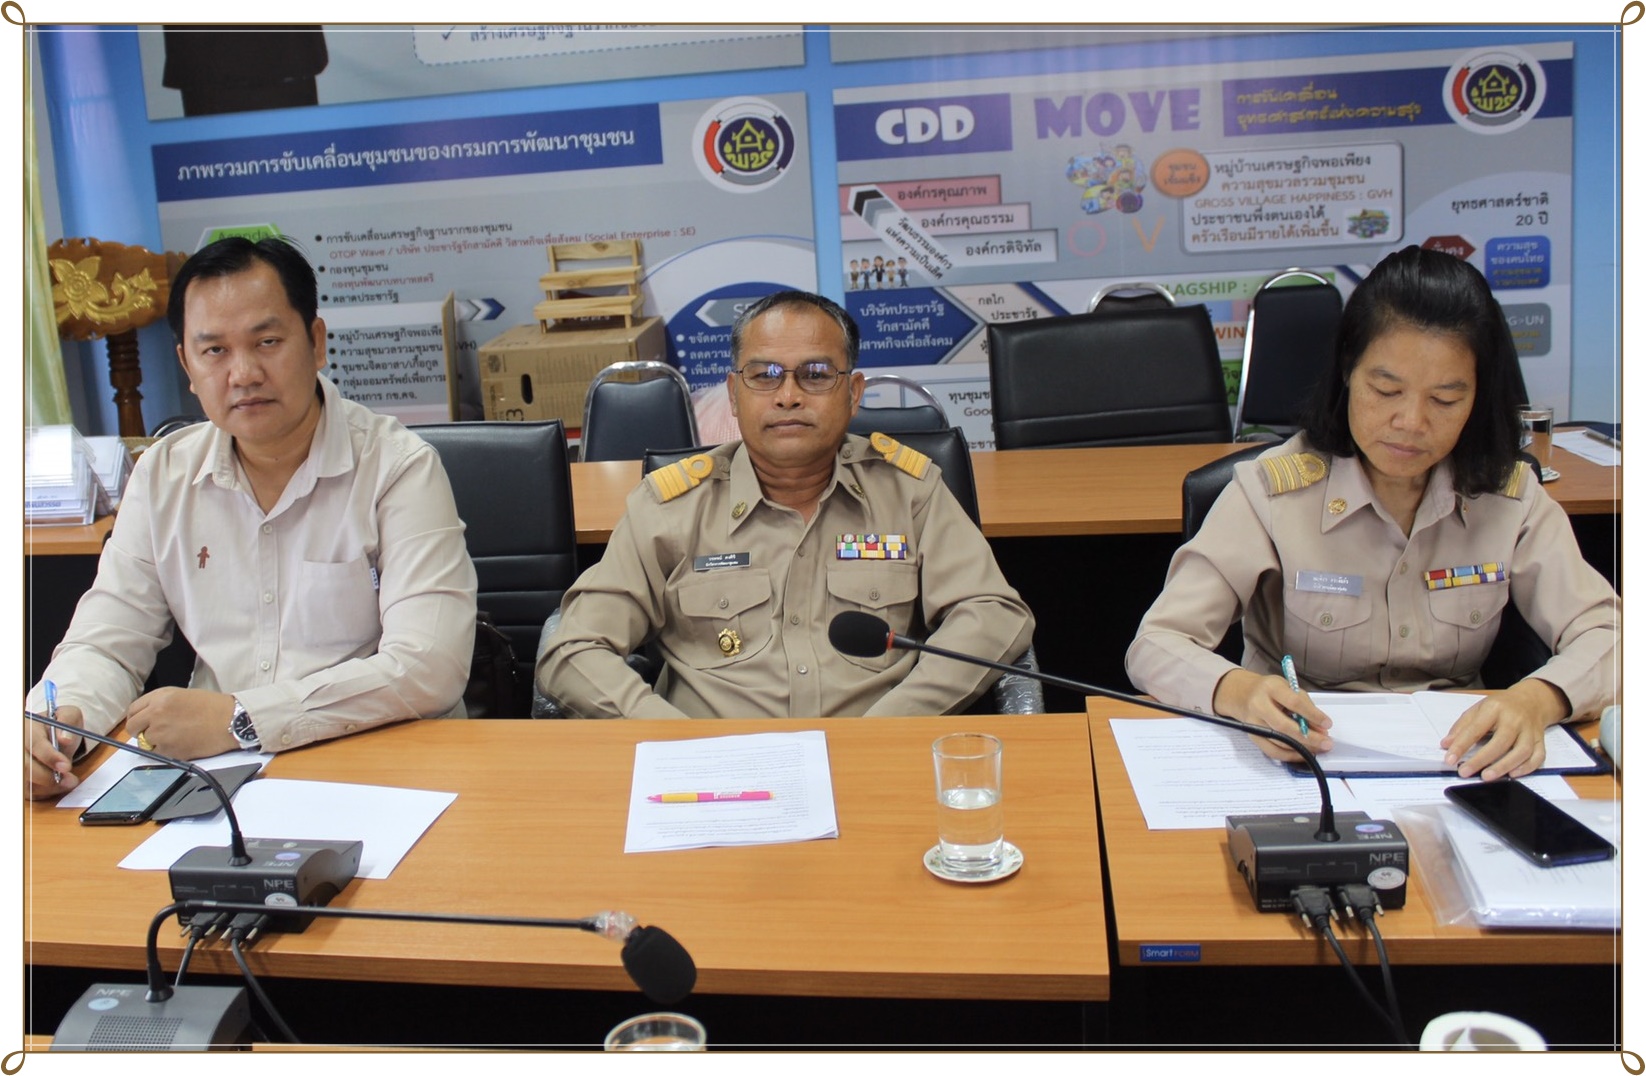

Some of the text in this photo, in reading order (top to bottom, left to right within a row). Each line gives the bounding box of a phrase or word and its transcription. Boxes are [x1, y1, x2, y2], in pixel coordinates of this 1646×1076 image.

[875, 88, 1201, 145] CDD MOVE
[177, 129, 635, 181] ภาพรวมการขับเคลื่อนชุมชนของกรมการพัฒนาชุมชน
[1214, 153, 1371, 178] หมู่บ้านเศรษฐกิจพอเพียง
[897, 183, 988, 202] องค์กรคุณภาพ
[1194, 198, 1235, 209] GROSS
[1239, 195, 1287, 207] VILLAGE
[1293, 191, 1355, 204] HAPPINESS
[1367, 189, 1393, 200] GVH
[1451, 191, 1549, 214] ยุทธศาสตร์ชาติ
[921, 212, 1015, 231] องค์กรคุณธรรม
[1191, 205, 1325, 227] ประชาชนพึ่งตนเองได้
[1515, 211, 1549, 226] 20 ปี
[329, 249, 357, 260] OTOP
[360, 248, 385, 258] Wave
[584, 232, 617, 243] (Social
[621, 228, 671, 241] Enterprise
[680, 226, 696, 238] SE)
[966, 238, 1042, 256] องค์กรดิจิทัล
[329, 263, 389, 276] กองทุนชุมชน
[1166, 281, 1238, 296] LAGSHIP
[860, 300, 945, 317] บริษัทประชารัฐ
[876, 318, 930, 333] รักสามัคคี
[1369, 852, 1405, 863] NPE
[264, 879, 294, 889] NPE
[1146, 948, 1173, 957] Smart
[96, 988, 132, 997] NPE
